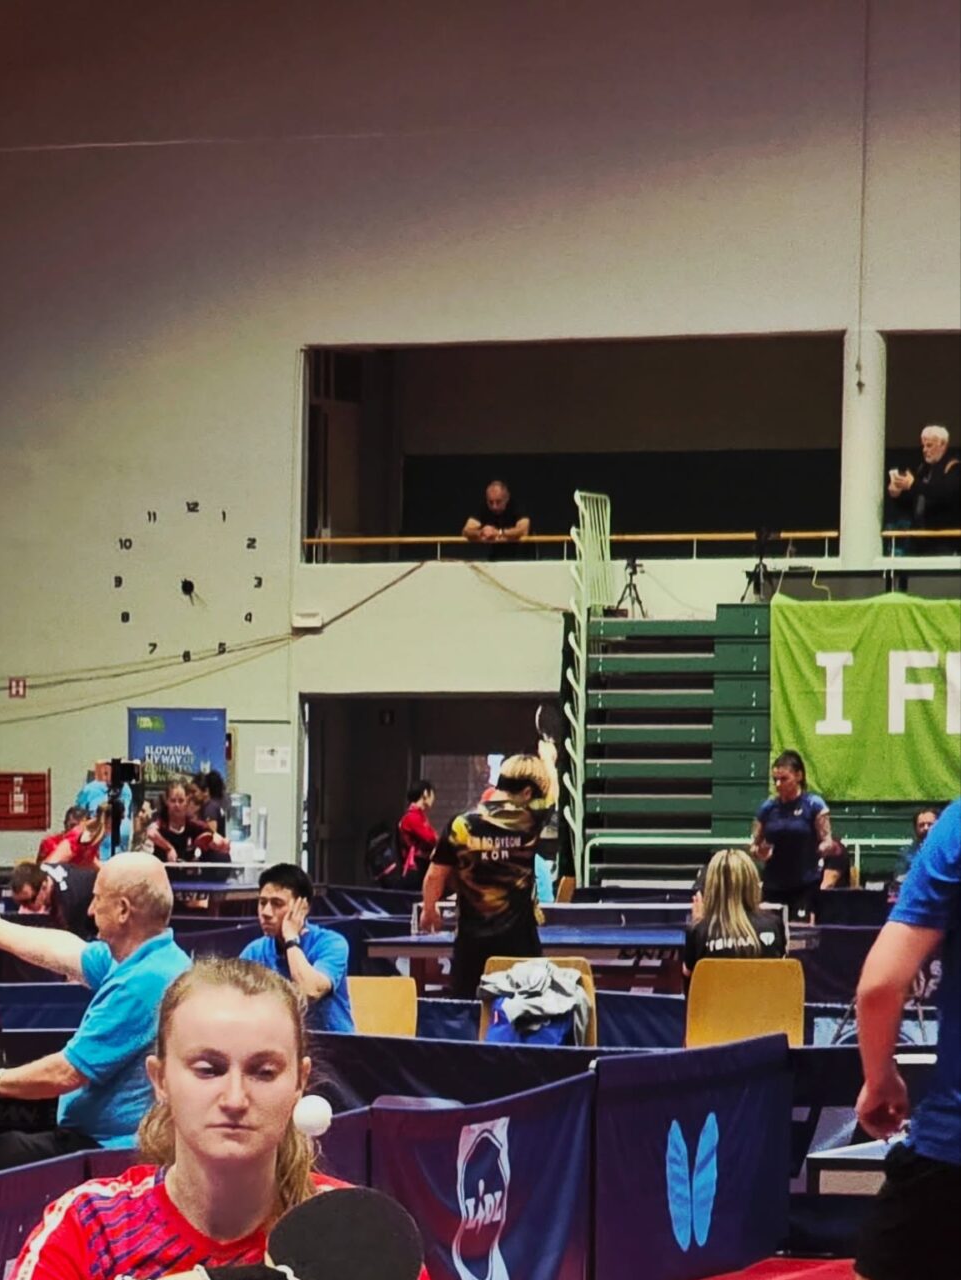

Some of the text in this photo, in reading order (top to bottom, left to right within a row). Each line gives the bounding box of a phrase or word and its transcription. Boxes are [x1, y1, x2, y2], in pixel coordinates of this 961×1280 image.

[185, 501, 199, 513] 12
[147, 511, 157, 523] 11
[221, 510, 227, 523] 1
[118, 538, 133, 550] 10
[246, 537, 257, 549] 2
[114, 575, 123, 588] 9
[254, 576, 263, 588] 3
[121, 611, 130, 623] 8
[244, 612, 253, 623] 4
[148, 643, 157, 654] 7
[218, 642, 227, 654] 5
[182, 650, 191, 662] 6
[815, 651, 854, 735] I
